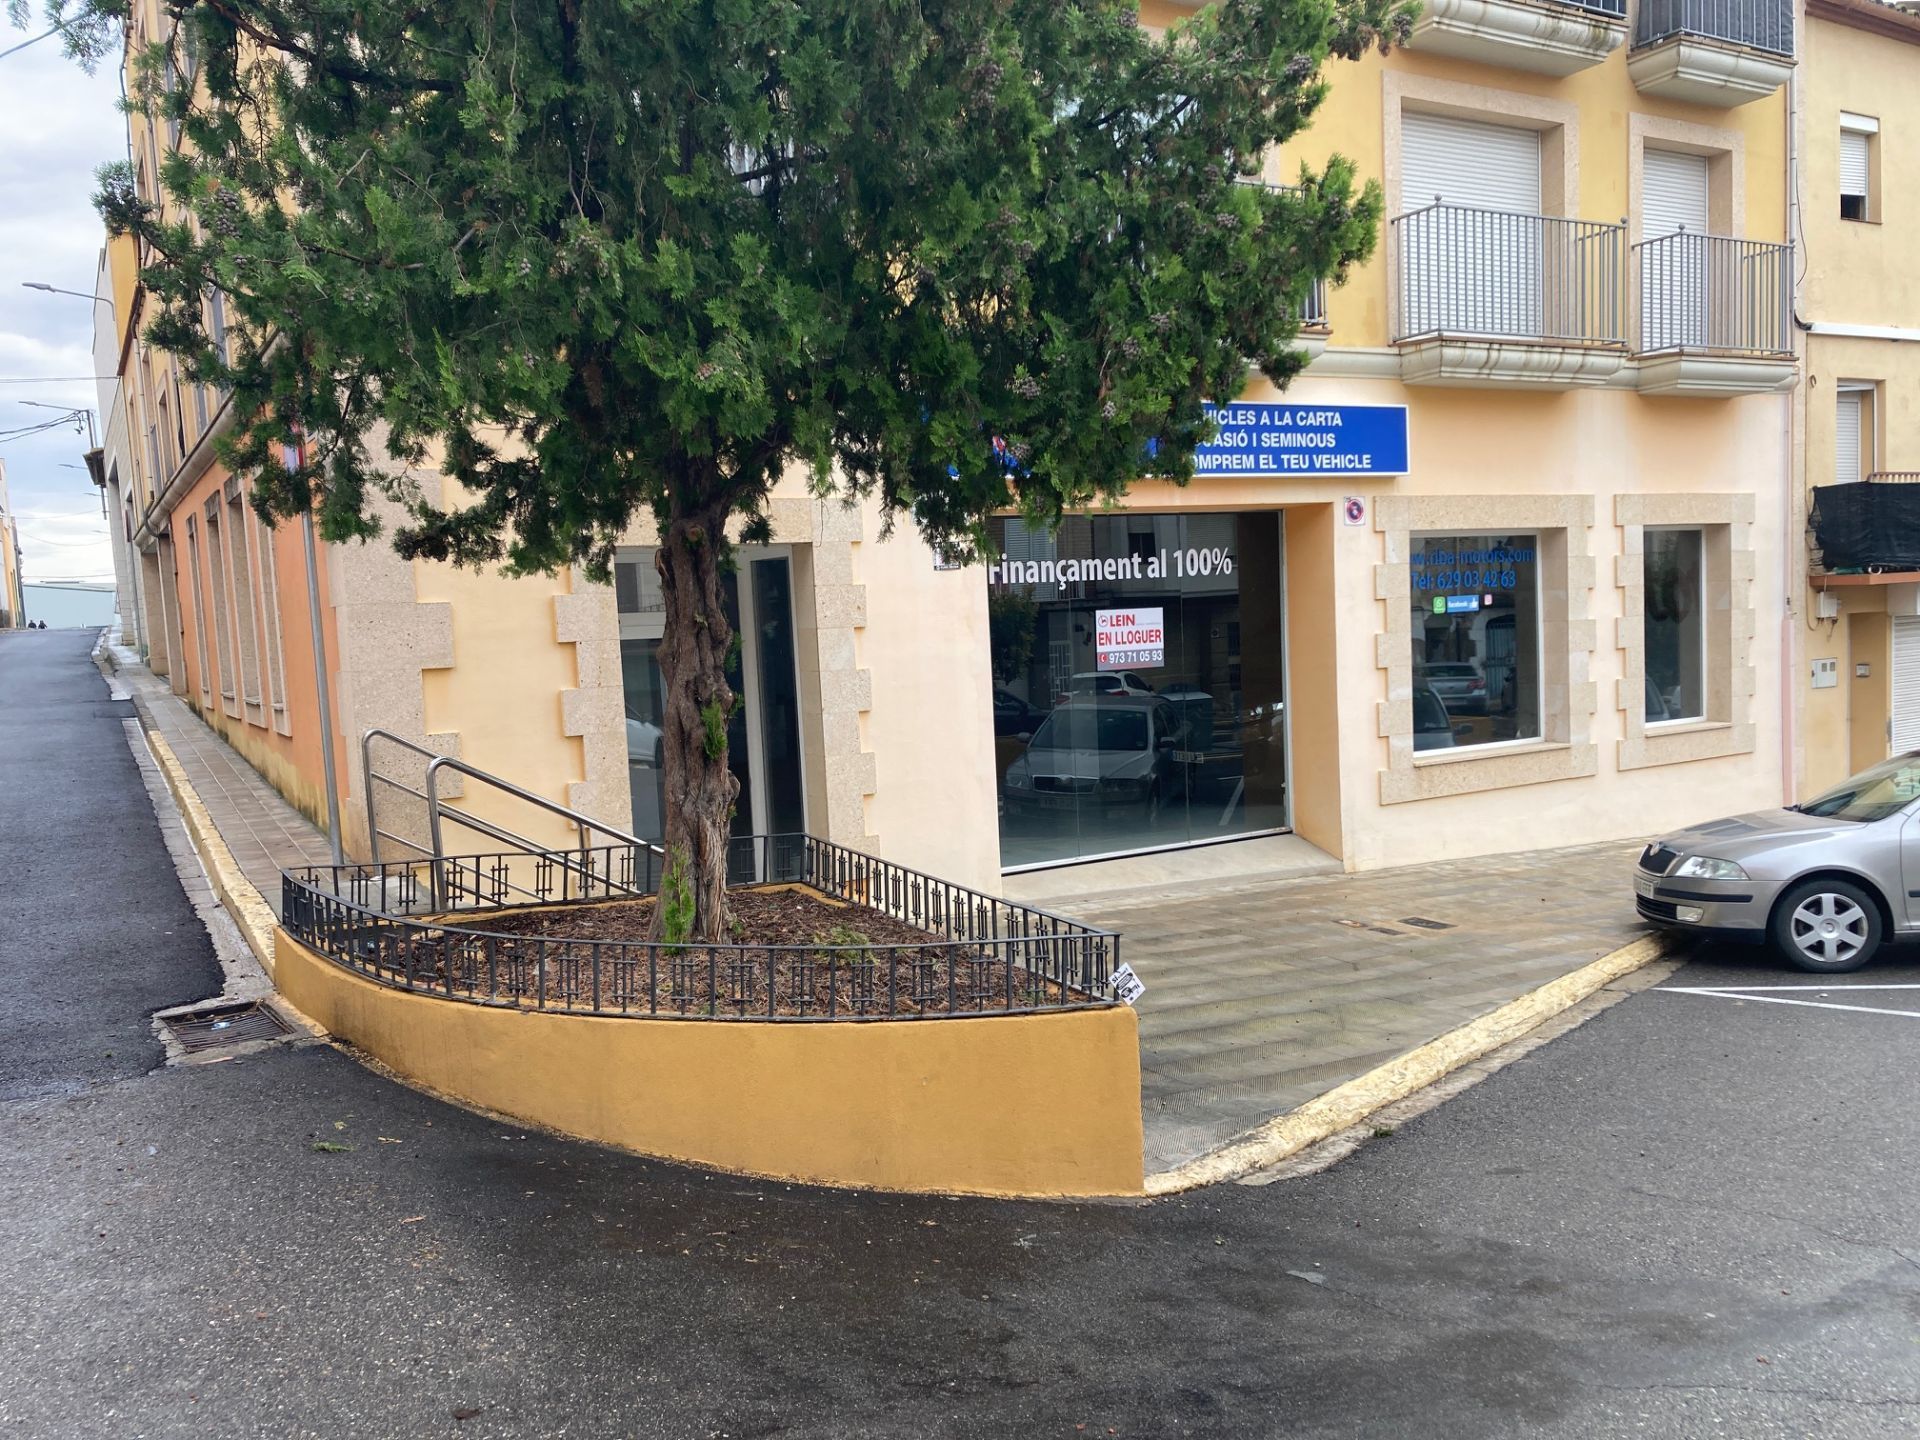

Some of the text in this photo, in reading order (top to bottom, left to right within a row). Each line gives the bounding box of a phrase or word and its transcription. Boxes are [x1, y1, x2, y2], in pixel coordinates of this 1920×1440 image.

[1260, 411, 1271, 426] A
[1274, 411, 1293, 426] LA
[1296, 411, 1342, 426] CARTA
[1252, 432, 1257, 448] I
[1261, 432, 1336, 448] SEMINOUS
[1259, 454, 1278, 469] EL
[1281, 454, 1310, 469] TEU
[1313, 454, 1372, 469] VEHICLE
[1147, 548, 1167, 578] al
[1173, 548, 1232, 578] 100%
[1437, 570, 1461, 589] 629
[1464, 570, 1479, 588] 03
[1483, 570, 1498, 588] 42
[1501, 570, 1516, 587] 63
[1110, 614, 1135, 627] LEIN
[1099, 629, 1162, 646] EN LLOGUER
[1109, 650, 1162, 663] 973 71 05 93
